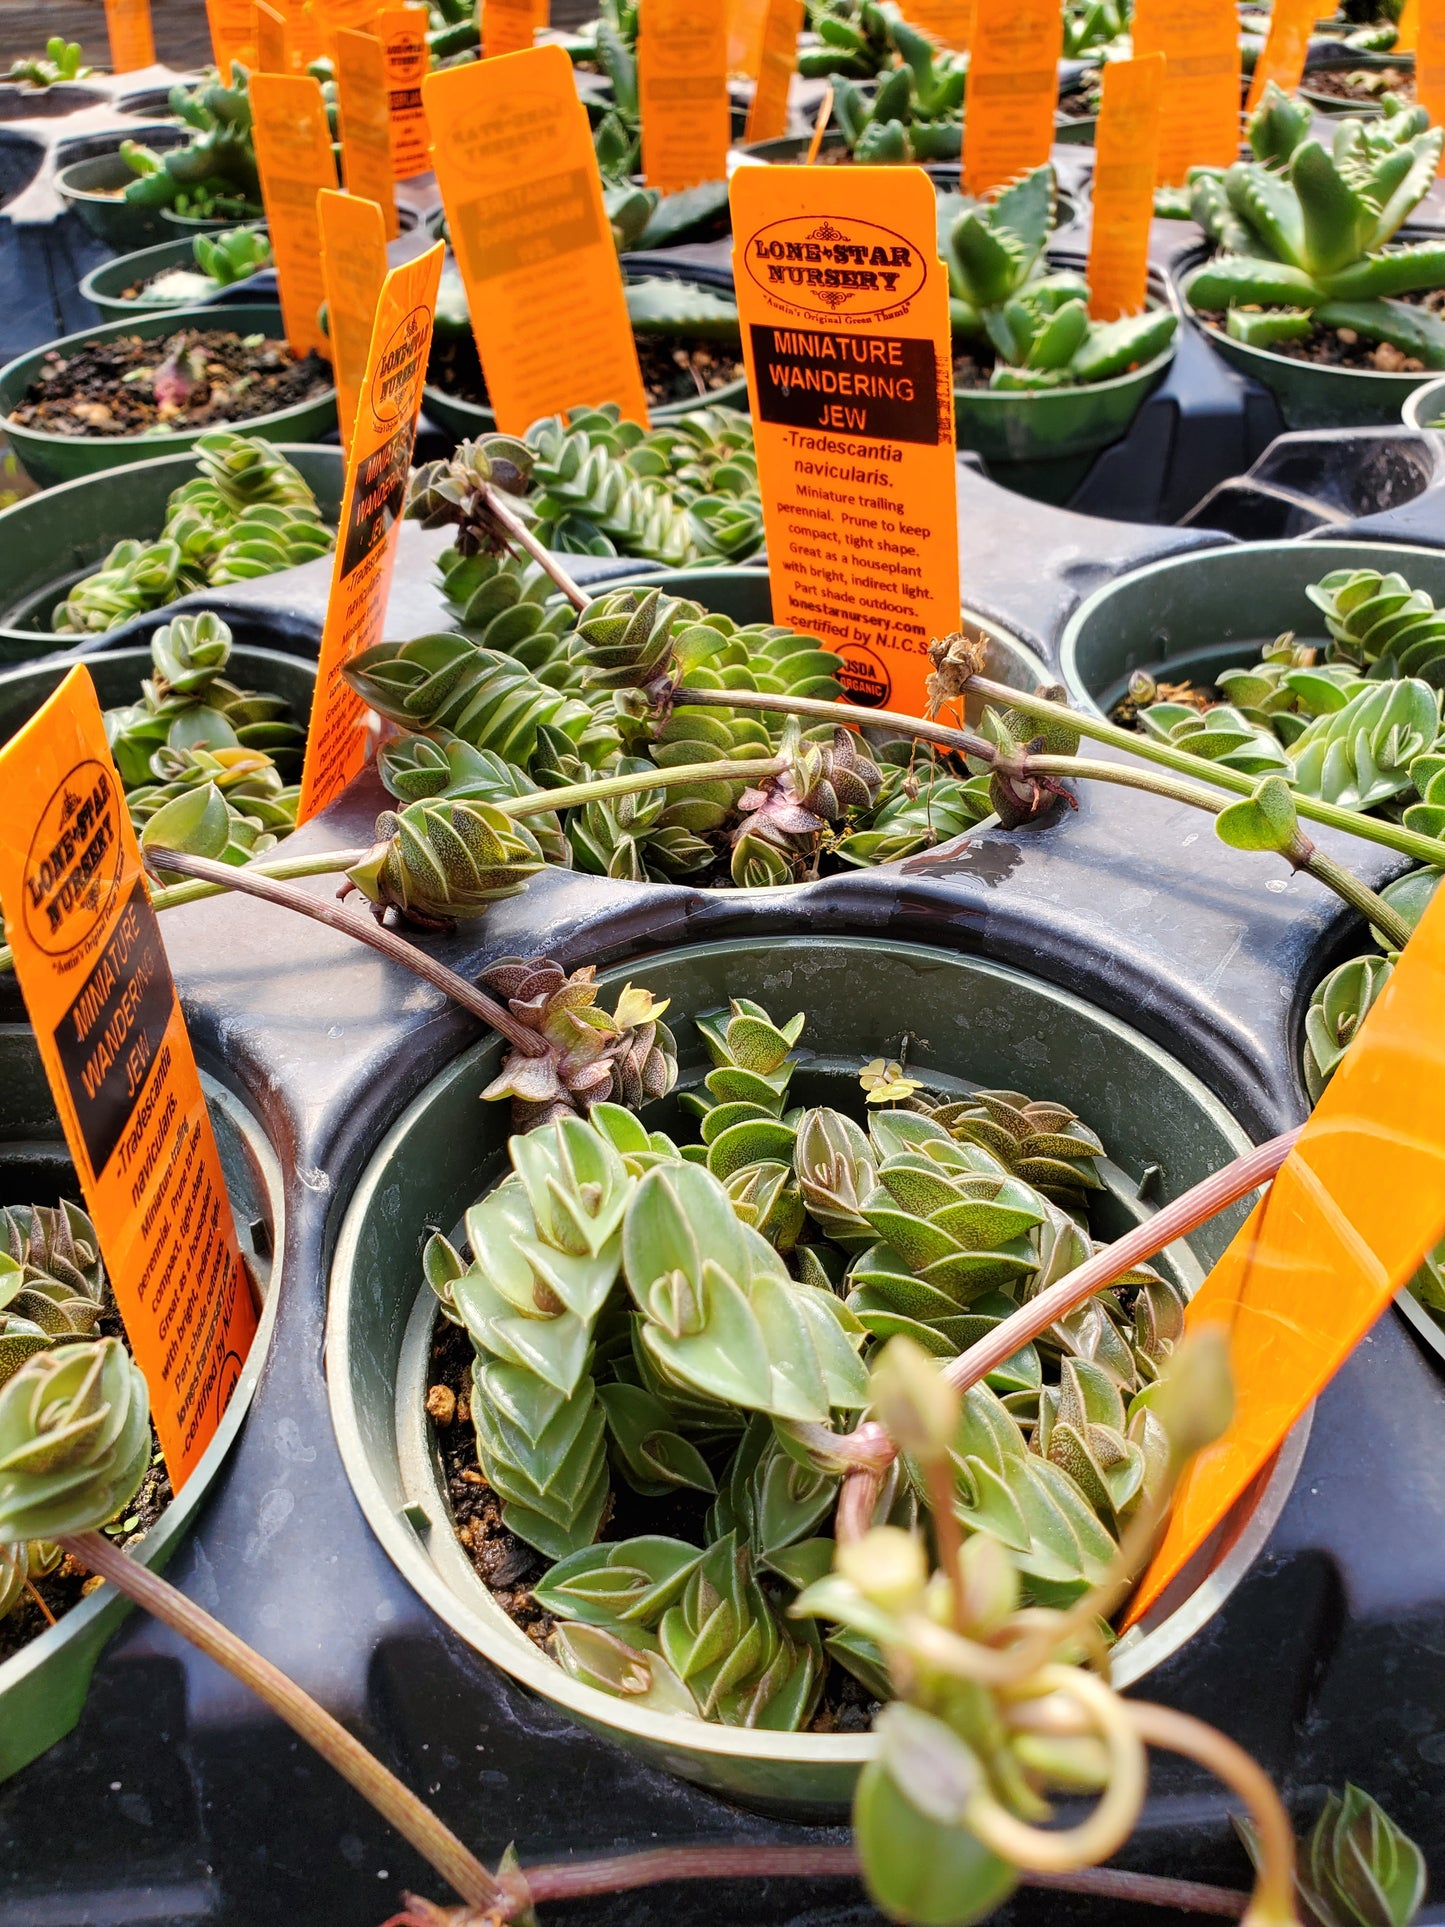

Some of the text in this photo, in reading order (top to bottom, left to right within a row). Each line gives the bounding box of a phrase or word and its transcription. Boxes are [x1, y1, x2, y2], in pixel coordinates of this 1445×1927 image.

[767, 264, 901, 292] NURSERY
[803, 310, 843, 325] Original
[844, 316, 872, 324] Green
[773, 330, 904, 366] MINIATURE
[768, 363, 915, 402] WANDERING
[818, 404, 867, 431] JEW
[782, 430, 903, 463] -Tradescantia
[793, 460, 895, 488] navicularis.
[795, 483, 905, 516] Miniature trailing
[776, 501, 931, 540] perennial. Prune to keep
[788, 524, 920, 558] compact, tight shape.
[789, 542, 923, 578] Great as a houseplant
[782, 559, 935, 601] with bright, indirect light.
[794, 580, 919, 618] Part shade outdoors.
[785, 615, 850, 639] -certified
[853, 627, 872, 647] by
[788, 594, 926, 636] lonestarnursery.com
[45, 811, 115, 936] NURSERY
[84, 917, 108, 955] Original
[71, 903, 141, 1042] MINIATURE
[80, 945, 155, 1101] WANDERING
[124, 1026, 152, 1099] JEW
[116, 1044, 172, 1180] -Tradescantia
[131, 1092, 178, 1208] navicularis.
[140, 1163, 174, 1241] Miniature
[136, 1215, 173, 1304] perennial.
[170, 1168, 188, 1216] Prune
[185, 1152, 194, 1174] to
[150, 1239, 183, 1315] compact,
[179, 1199, 194, 1240] tight
[158, 1177, 213, 1342] Great as a houseplant
[160, 1339, 180, 1384] with
[176, 1287, 200, 1344] bright,
[194, 1235, 214, 1289] indirect
[173, 1351, 192, 1395] Part
[189, 1304, 209, 1355] shade
[215, 1330, 227, 1368] by
